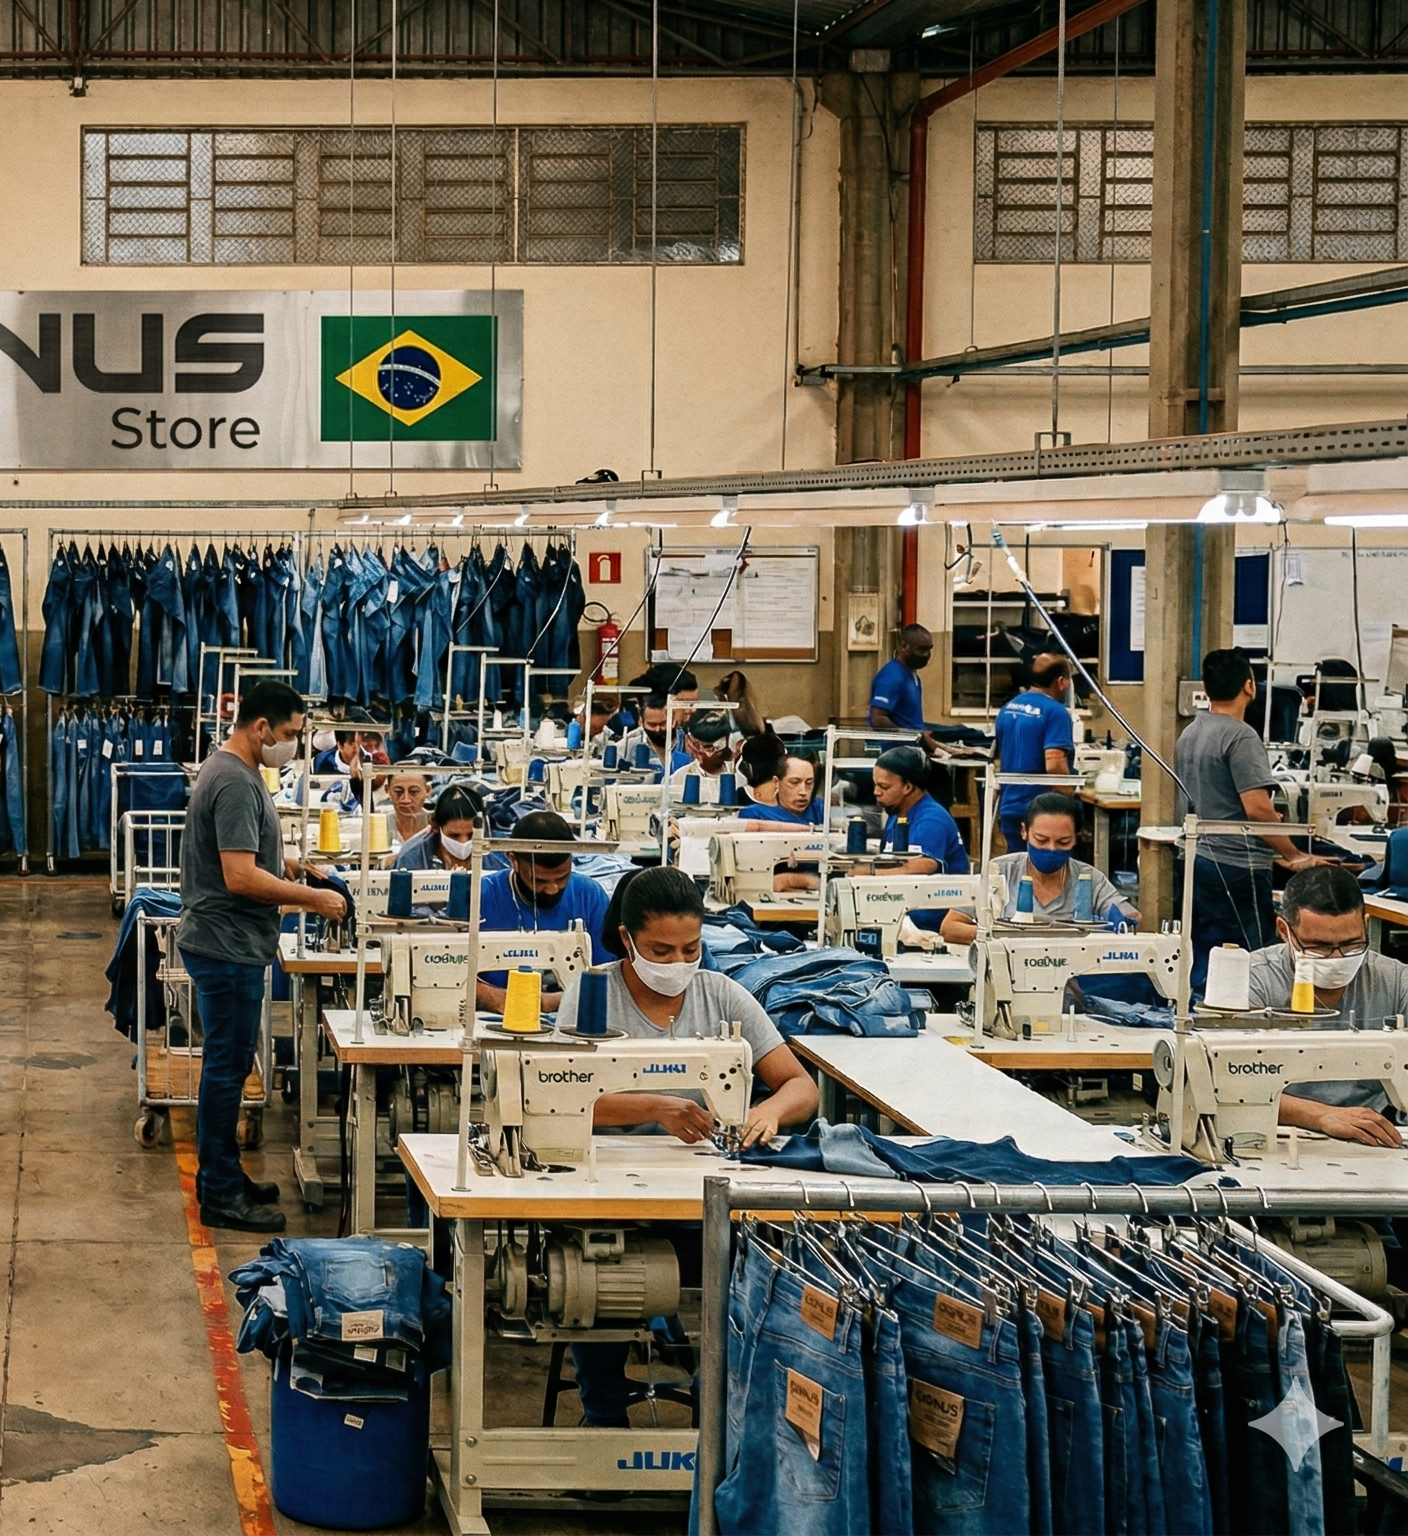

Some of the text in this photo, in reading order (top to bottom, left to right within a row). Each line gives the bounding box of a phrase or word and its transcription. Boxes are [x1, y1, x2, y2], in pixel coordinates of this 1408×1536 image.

[111, 406, 261, 450] Store
[538, 1070, 595, 1083] brother
[1228, 1061, 1284, 1075] brother
[617, 1451, 696, 1471] JUK
